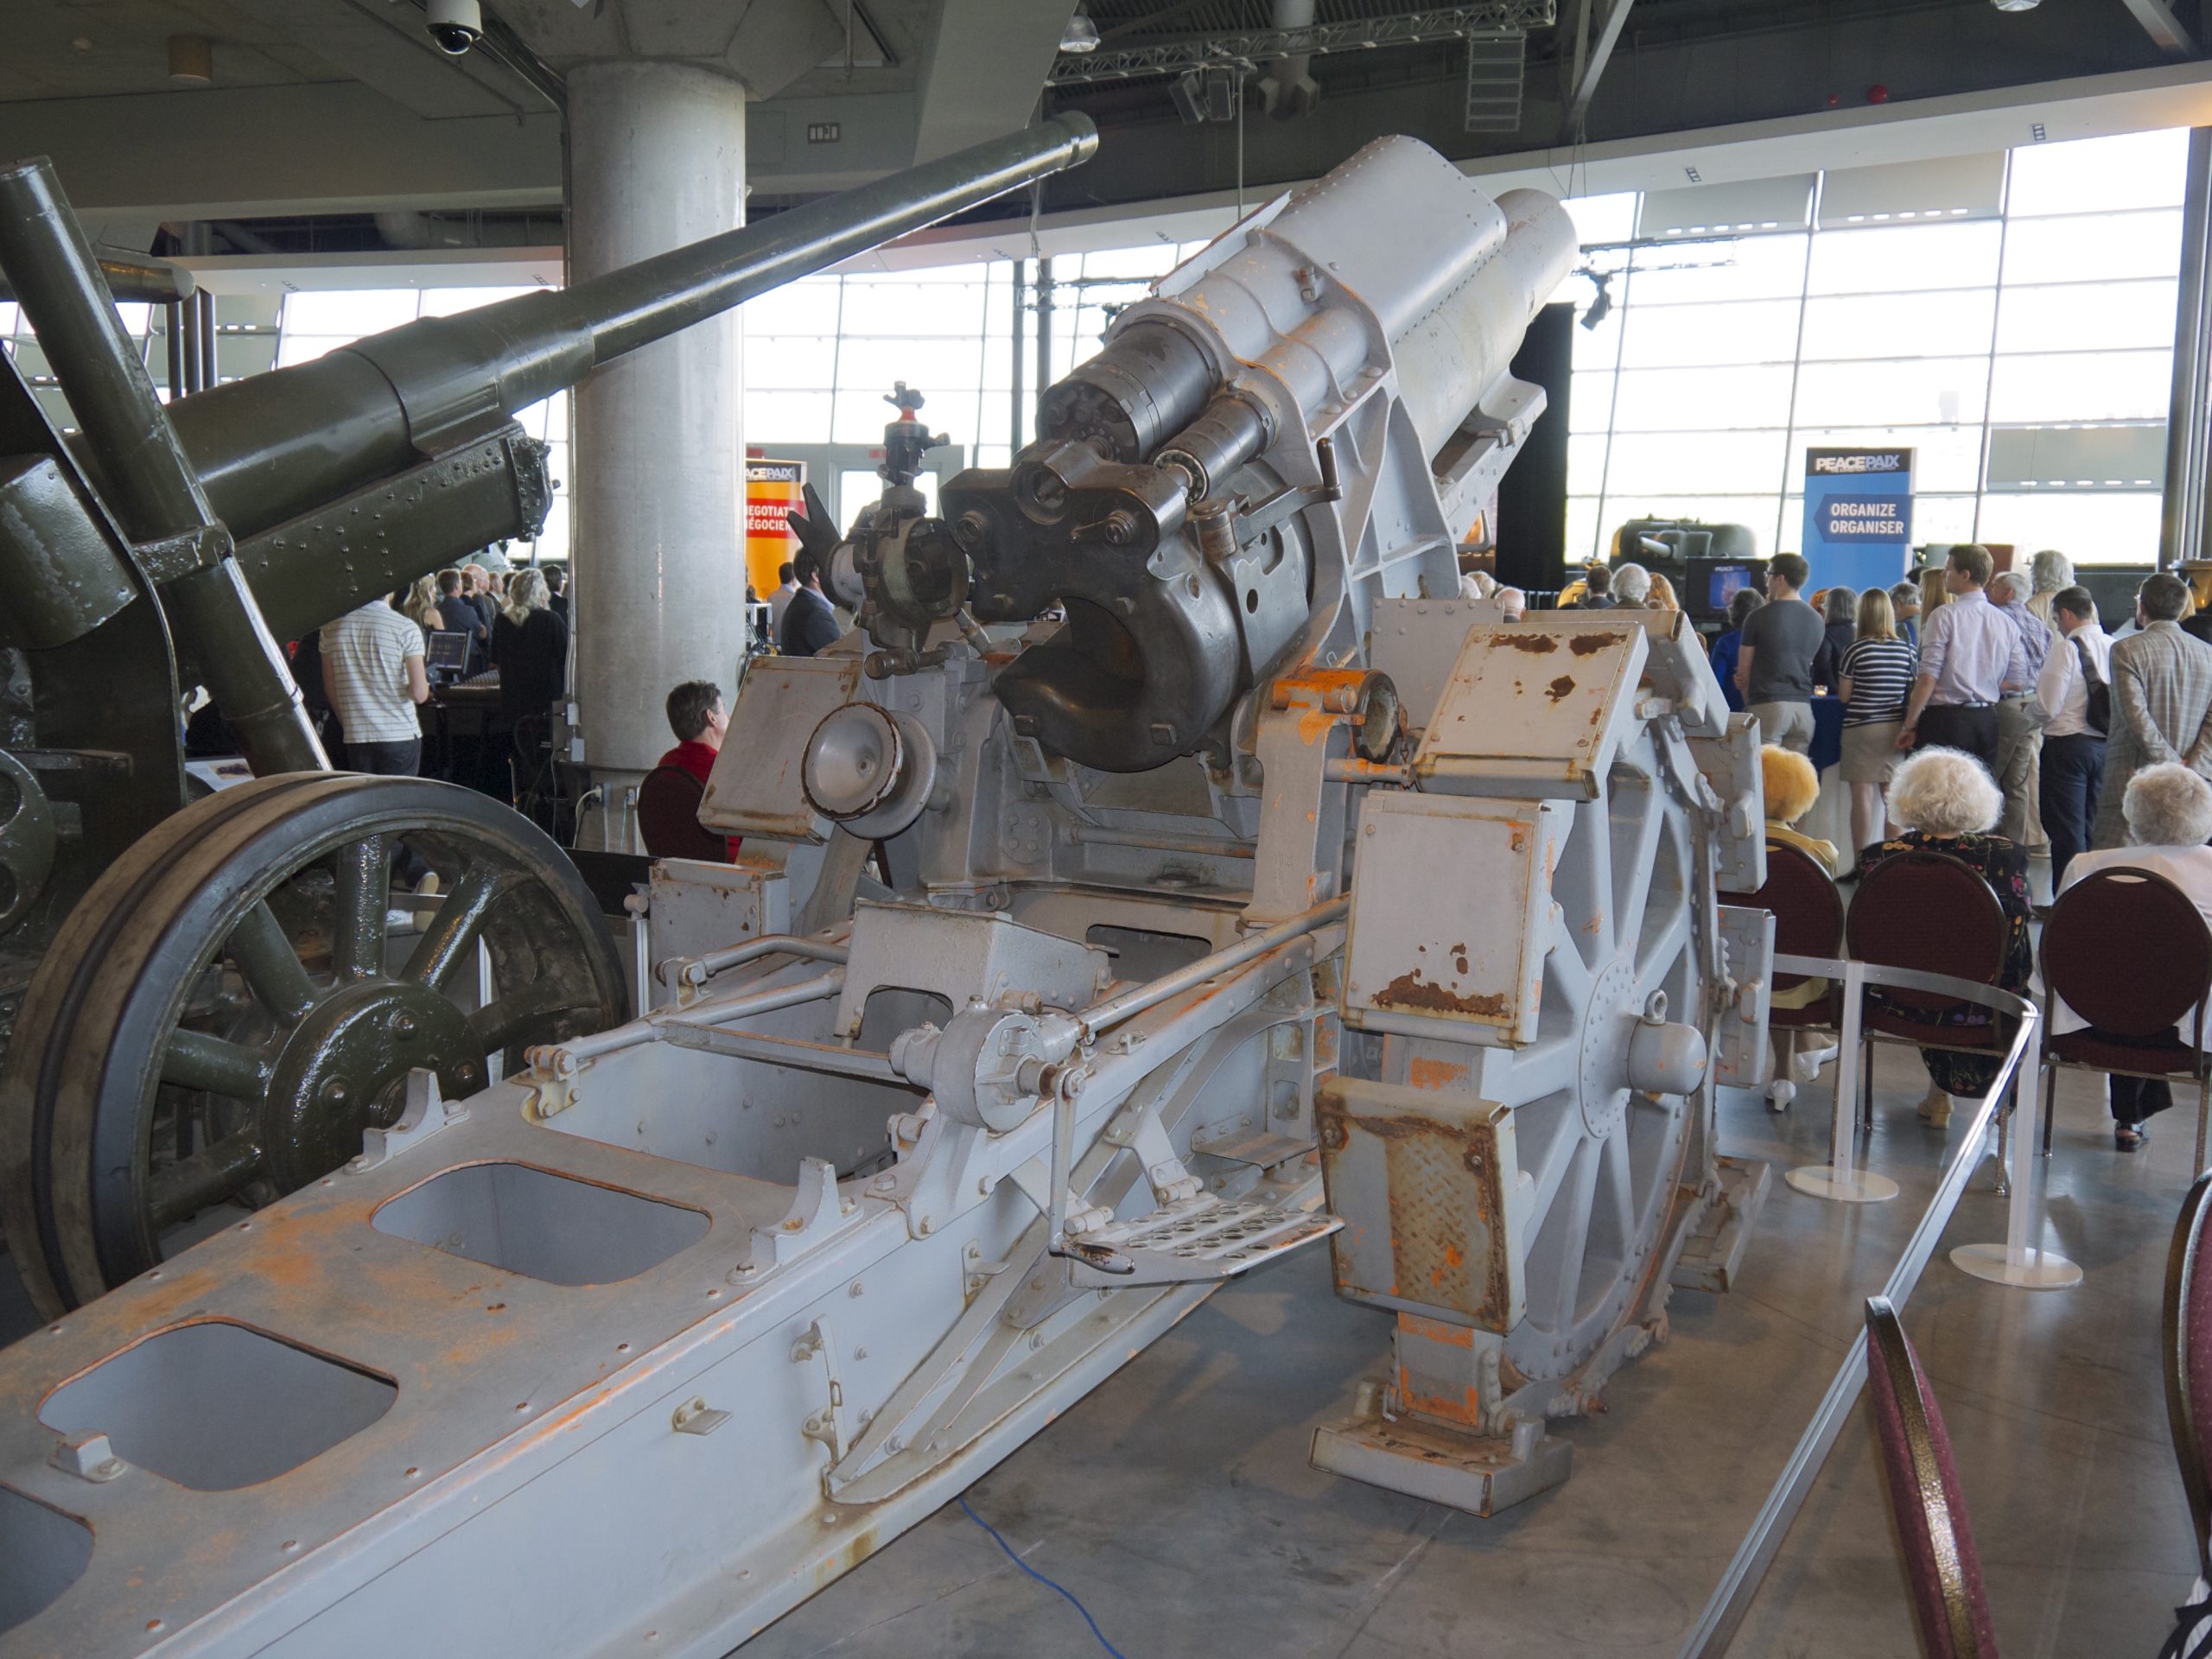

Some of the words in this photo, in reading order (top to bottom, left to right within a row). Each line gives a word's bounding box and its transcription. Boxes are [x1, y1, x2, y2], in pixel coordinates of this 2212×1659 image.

[747, 467, 794, 480] ACEPAIX
[747, 505, 795, 518] EGOTIAT
[1830, 503, 1897, 517] ORGANIZE
[747, 517, 791, 531] ÉGOCIER
[1829, 520, 1904, 534] ORGANISER
